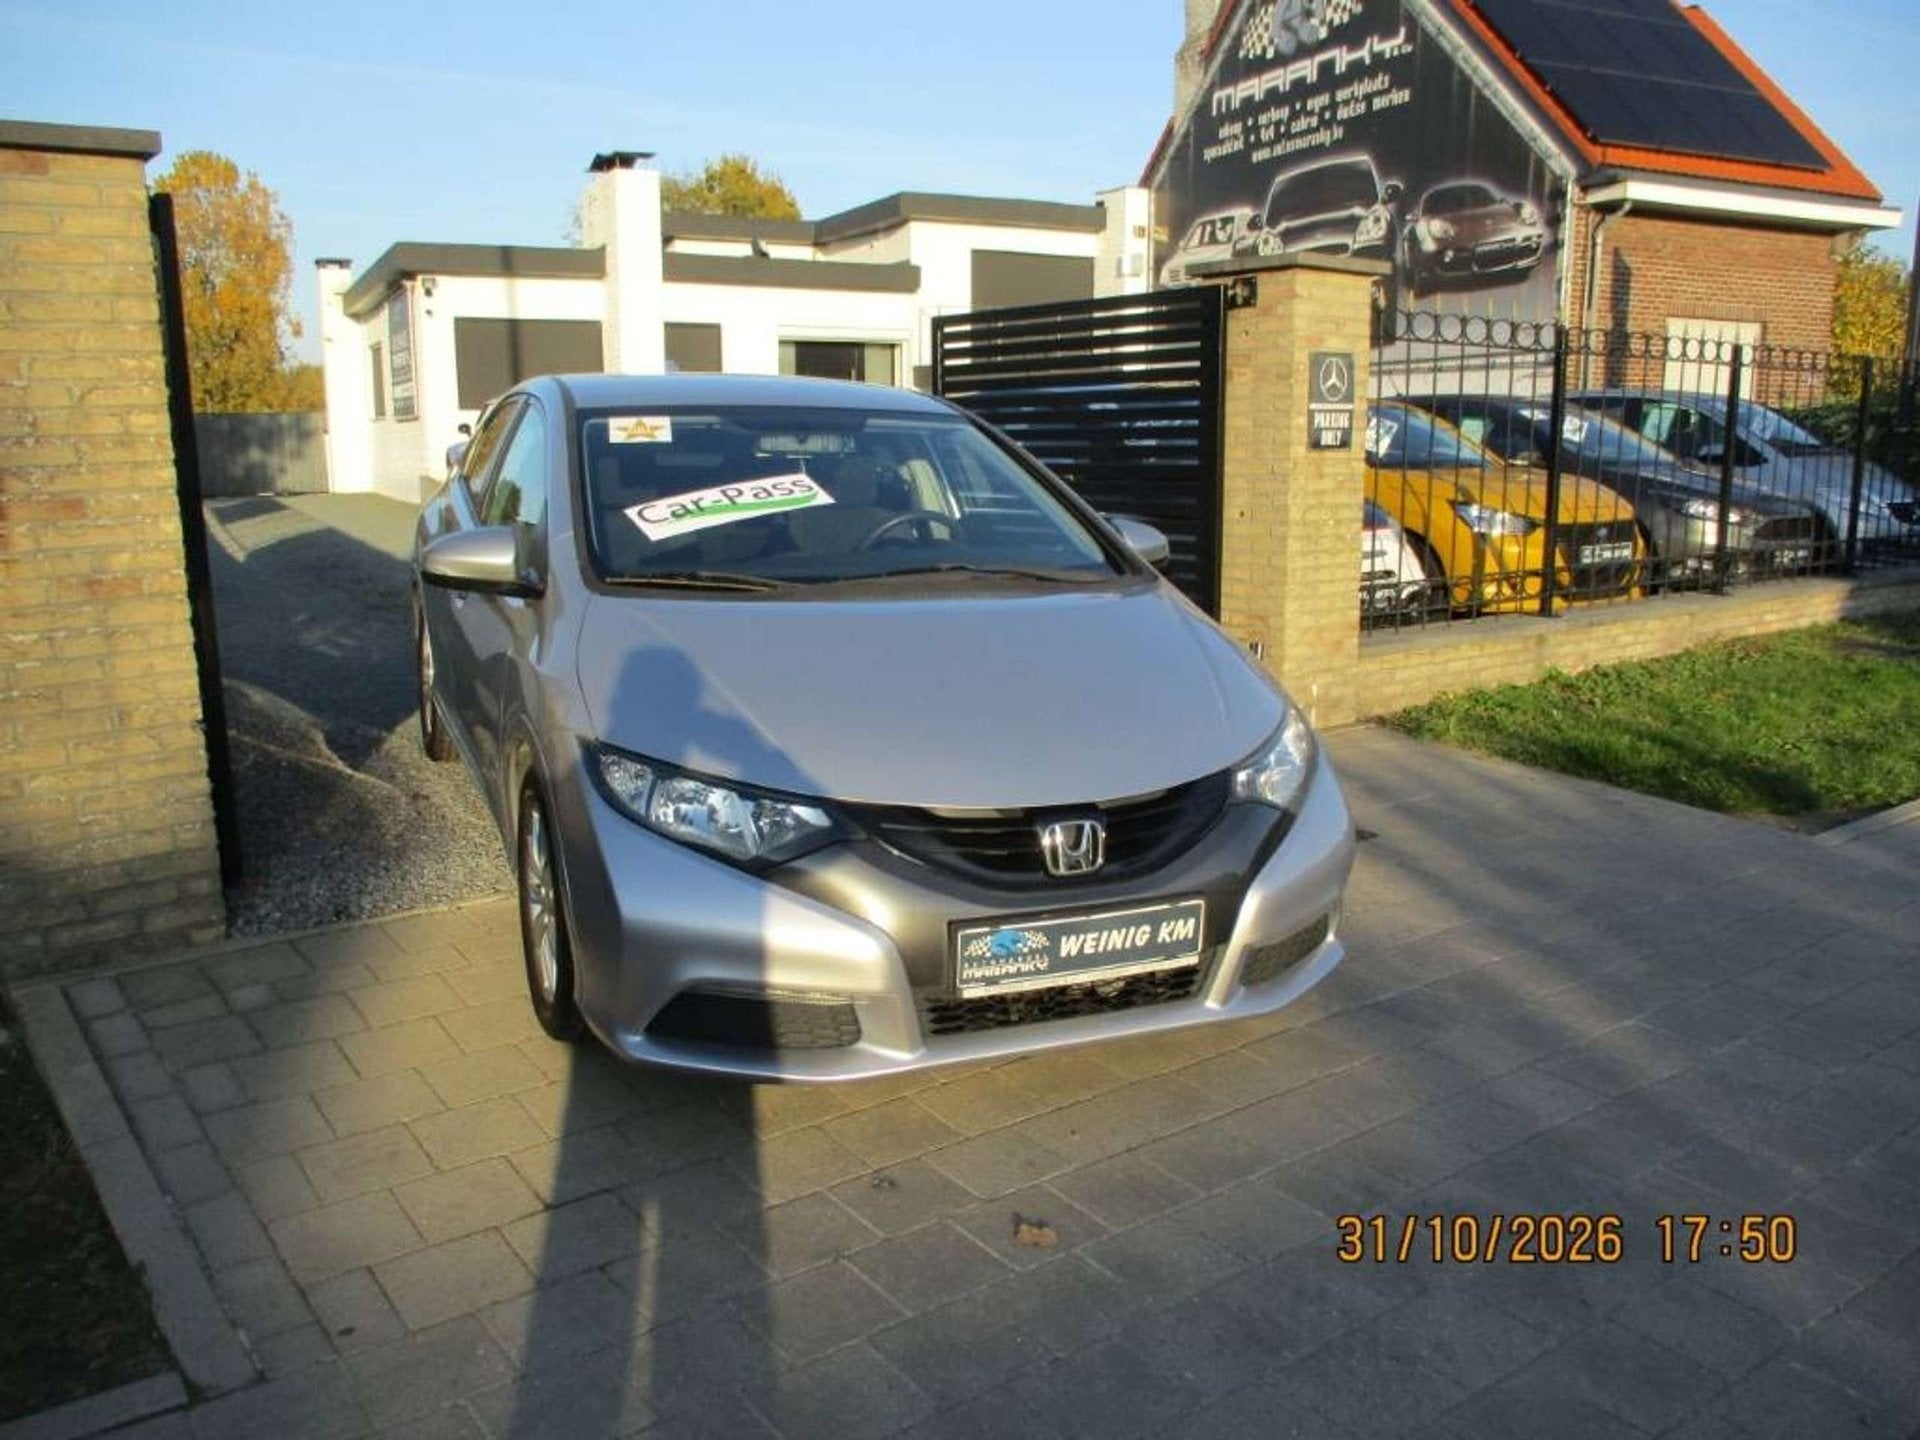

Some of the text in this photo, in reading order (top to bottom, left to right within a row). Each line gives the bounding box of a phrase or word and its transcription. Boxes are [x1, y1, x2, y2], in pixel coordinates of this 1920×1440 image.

[636, 476, 815, 525] Car-Pass
[1058, 917, 1197, 958] WEINIG KM
